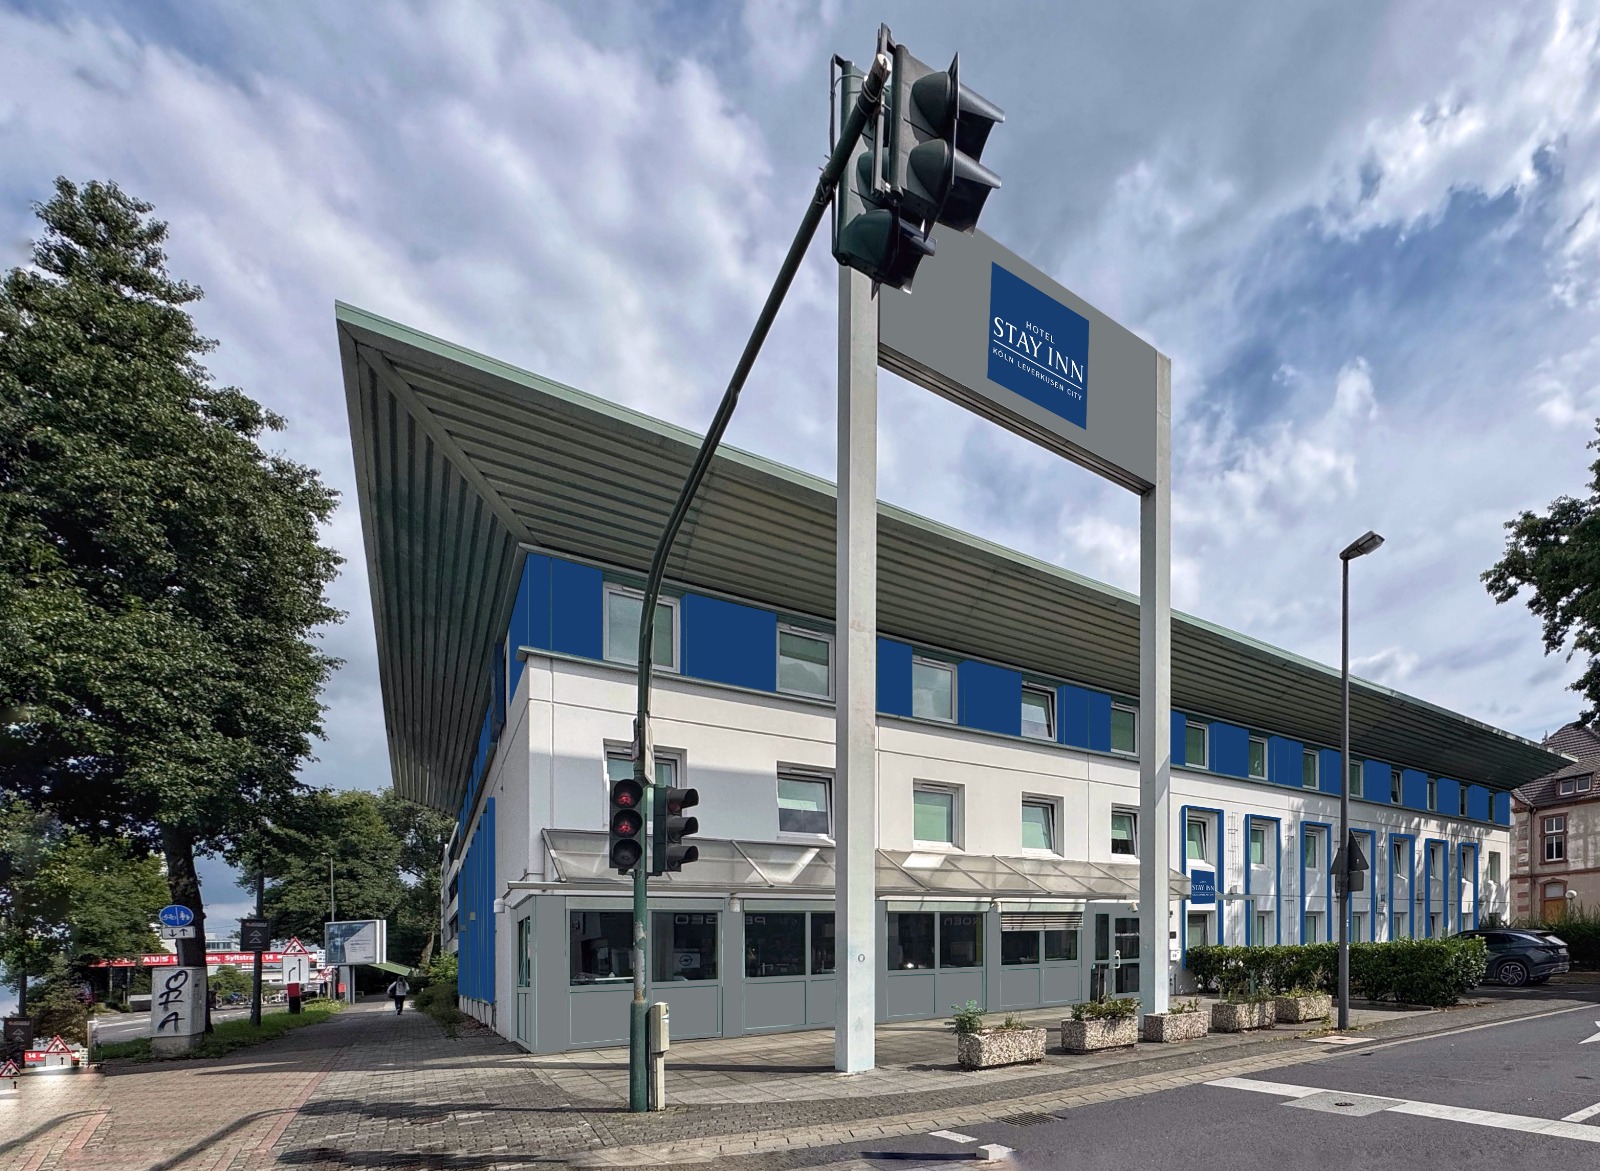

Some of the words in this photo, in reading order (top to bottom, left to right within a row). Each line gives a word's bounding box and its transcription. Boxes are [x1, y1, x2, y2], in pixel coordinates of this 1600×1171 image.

[993, 316, 1042, 358] STAY
[1048, 346, 1083, 383] INN
[1025, 320, 1055, 344] HOTEL
[992, 346, 1014, 364] KÖLN
[1017, 360, 1064, 392] LEVERKUSEN
[1066, 388, 1082, 401] CITY
